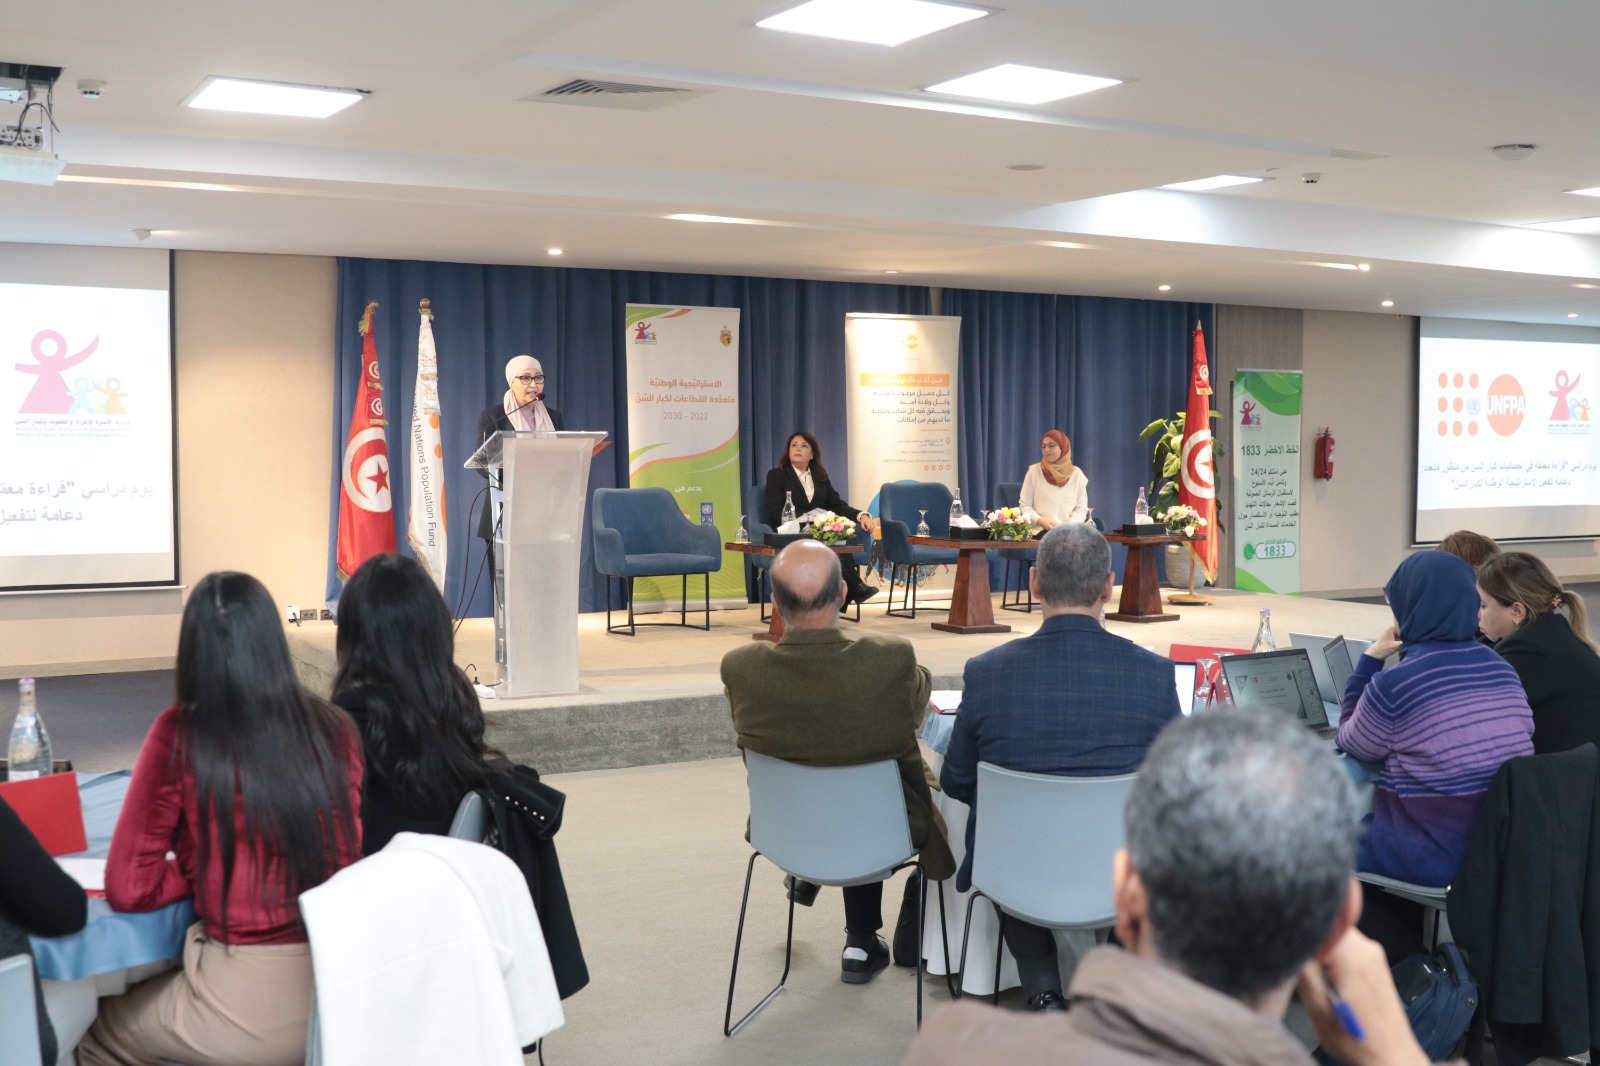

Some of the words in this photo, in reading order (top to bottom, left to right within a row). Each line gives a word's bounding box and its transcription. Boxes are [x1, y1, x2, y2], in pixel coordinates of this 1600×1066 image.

[656, 394, 672, 405] لكبار
[673, 394, 708, 404] القطاعات
[1487, 395, 1525, 415] UNFPA
[663, 411, 683, 421] 2030
[690, 412, 708, 421] 2022
[1241, 444, 1261, 456] 1833
[1250, 467, 1267, 478] 24/24
[81, 481, 126, 501] دراسي
[413, 424, 426, 464] Nations
[420, 465, 434, 519] Population
[427, 521, 437, 547] Fund
[686, 485, 703, 493] بدعم
[131, 486, 153, 501] يوم
[41, 505, 83, 522] دعامة
[1264, 545, 1286, 557] 1833
